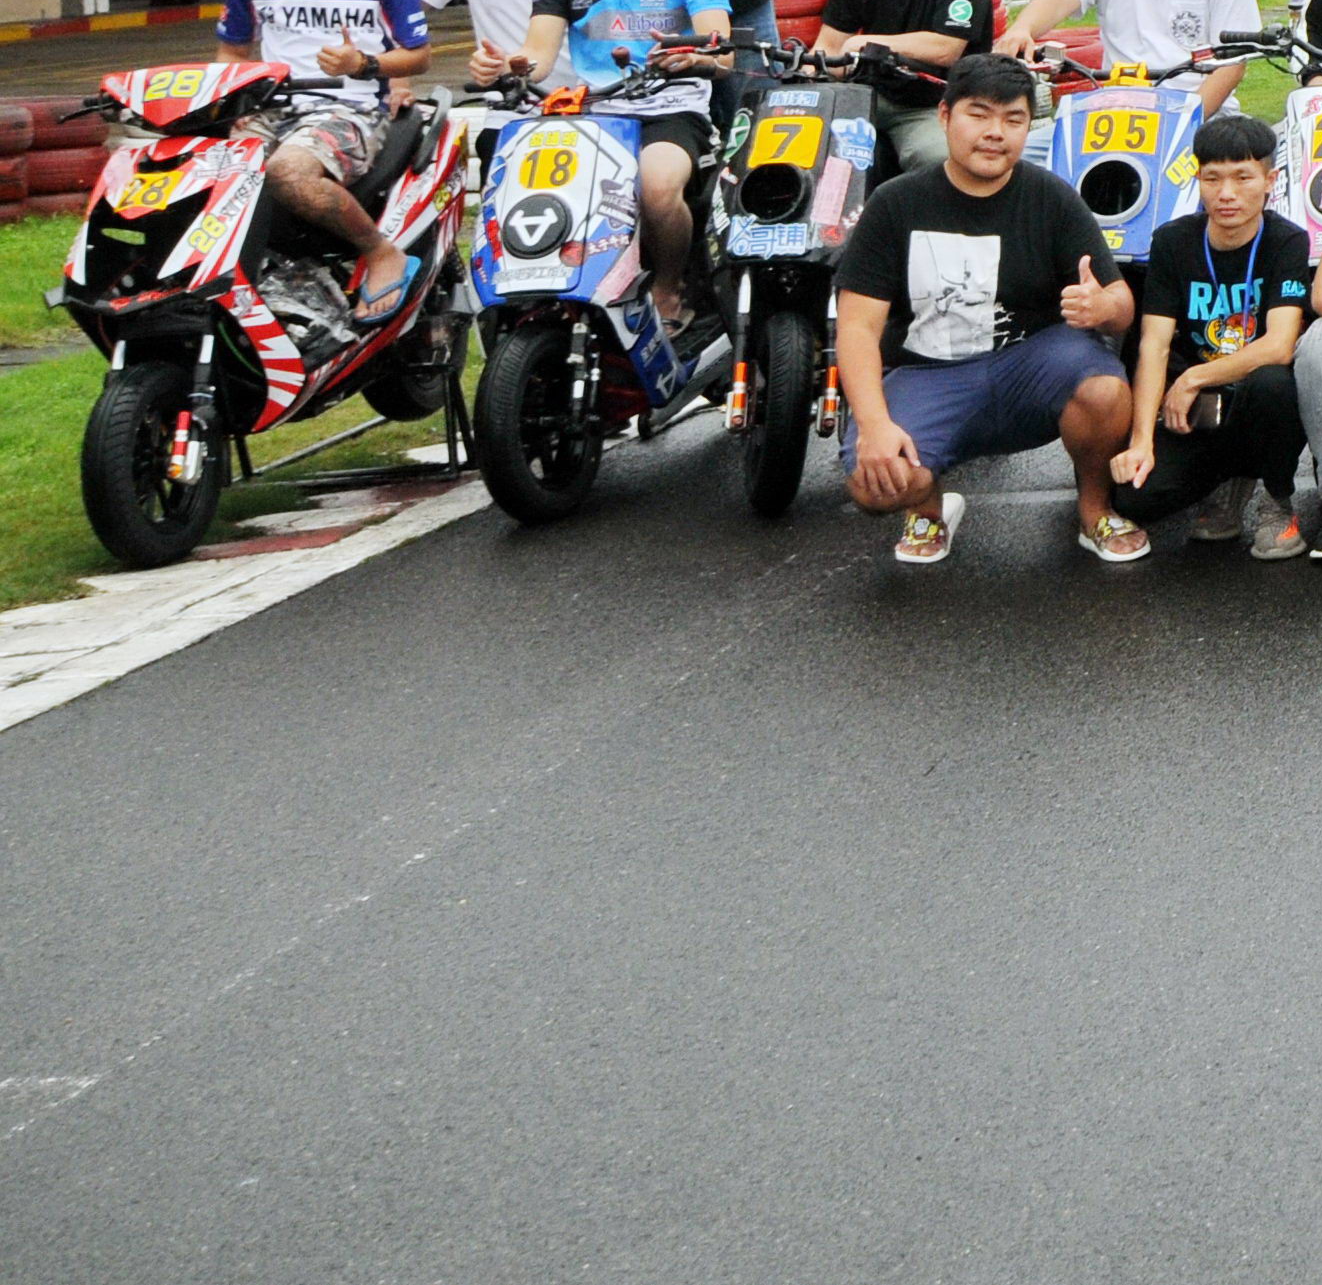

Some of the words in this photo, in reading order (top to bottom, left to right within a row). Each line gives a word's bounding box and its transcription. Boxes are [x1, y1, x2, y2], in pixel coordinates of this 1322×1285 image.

[282, 6, 375, 29] YAMAHA
[144, 69, 205, 102] 28
[770, 123, 804, 159] 7
[1089, 114, 1148, 150] 95
[526, 149, 574, 189] 18
[122, 176, 170, 206] 28
[188, 215, 227, 254] 28
